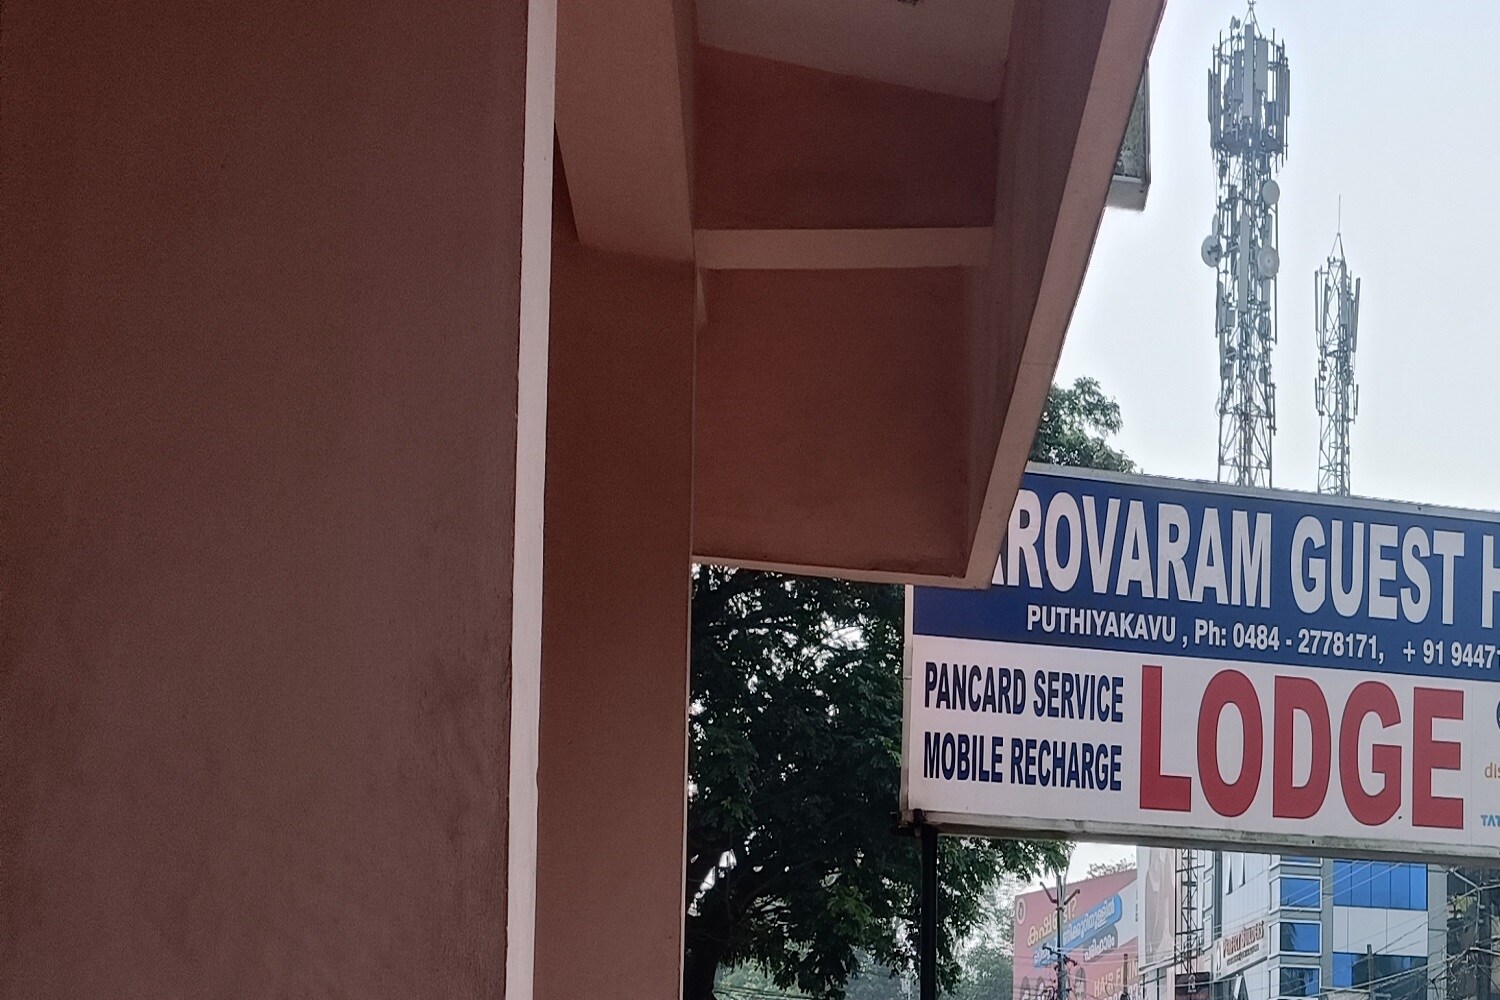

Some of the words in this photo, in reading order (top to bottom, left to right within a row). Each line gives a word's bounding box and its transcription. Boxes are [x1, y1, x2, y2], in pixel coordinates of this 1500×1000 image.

[992, 487, 1272, 609] ROVARAM
[1290, 514, 1466, 626] GUEST
[1026, 603, 1177, 643] PUTHIYAKAVU
[1194, 618, 1227, 646] Ph:
[1232, 622, 1280, 651] 0484
[1297, 627, 1385, 664] 2778171,
[924, 661, 1027, 716] PANCARD
[1033, 669, 1124, 723] SERVICE
[923, 731, 1004, 783] MOBILE
[1010, 737, 1123, 792] RECHARGE
[1139, 664, 1465, 830] LODGE
